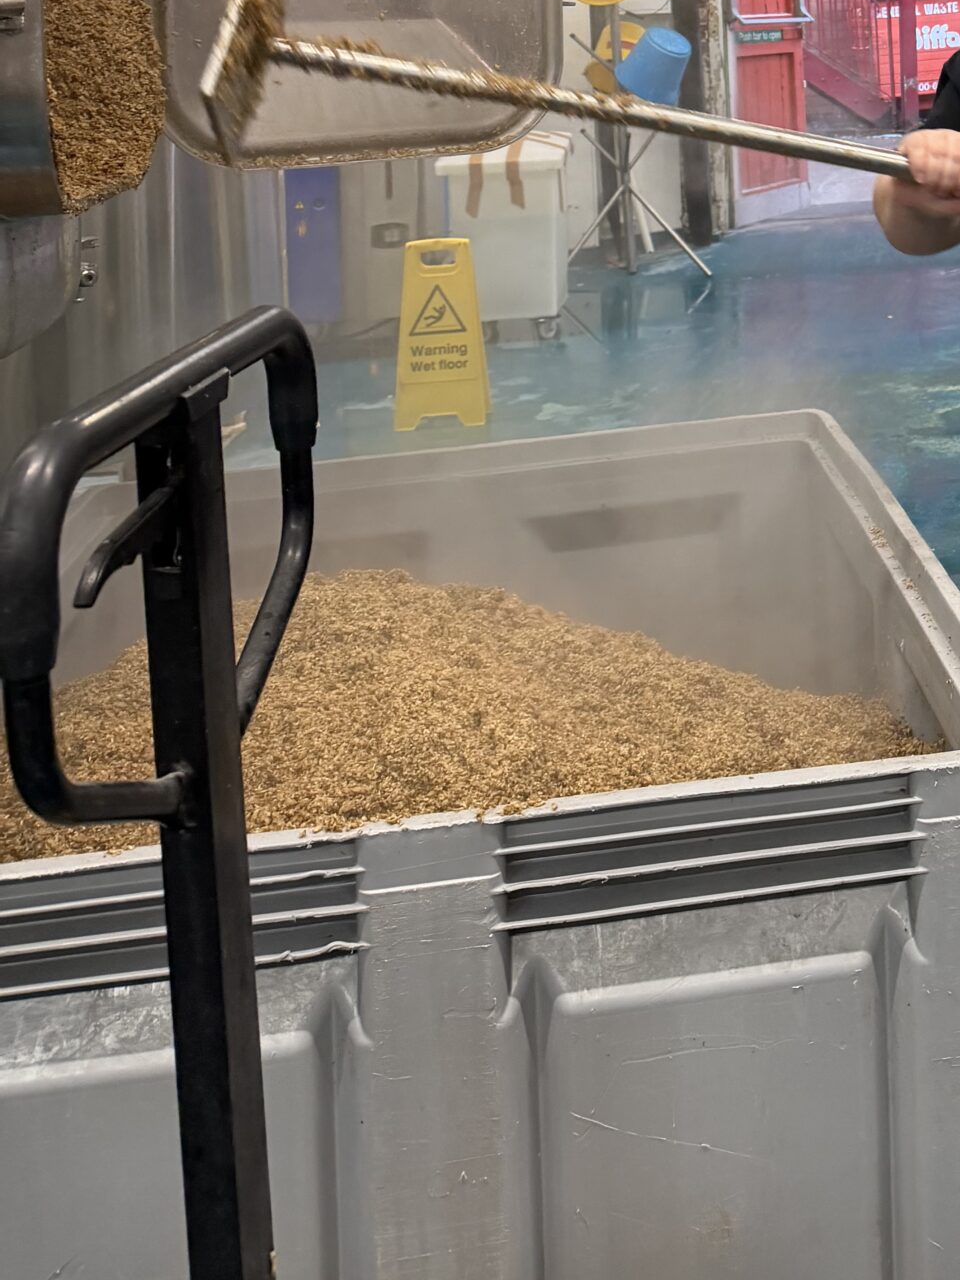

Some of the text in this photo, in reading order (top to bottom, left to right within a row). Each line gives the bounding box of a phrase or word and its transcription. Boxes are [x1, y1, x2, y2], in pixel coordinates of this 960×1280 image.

[924, 1, 960, 15] WASTE
[410, 342, 469, 357] Warning
[410, 358, 469, 373] Wet floor
